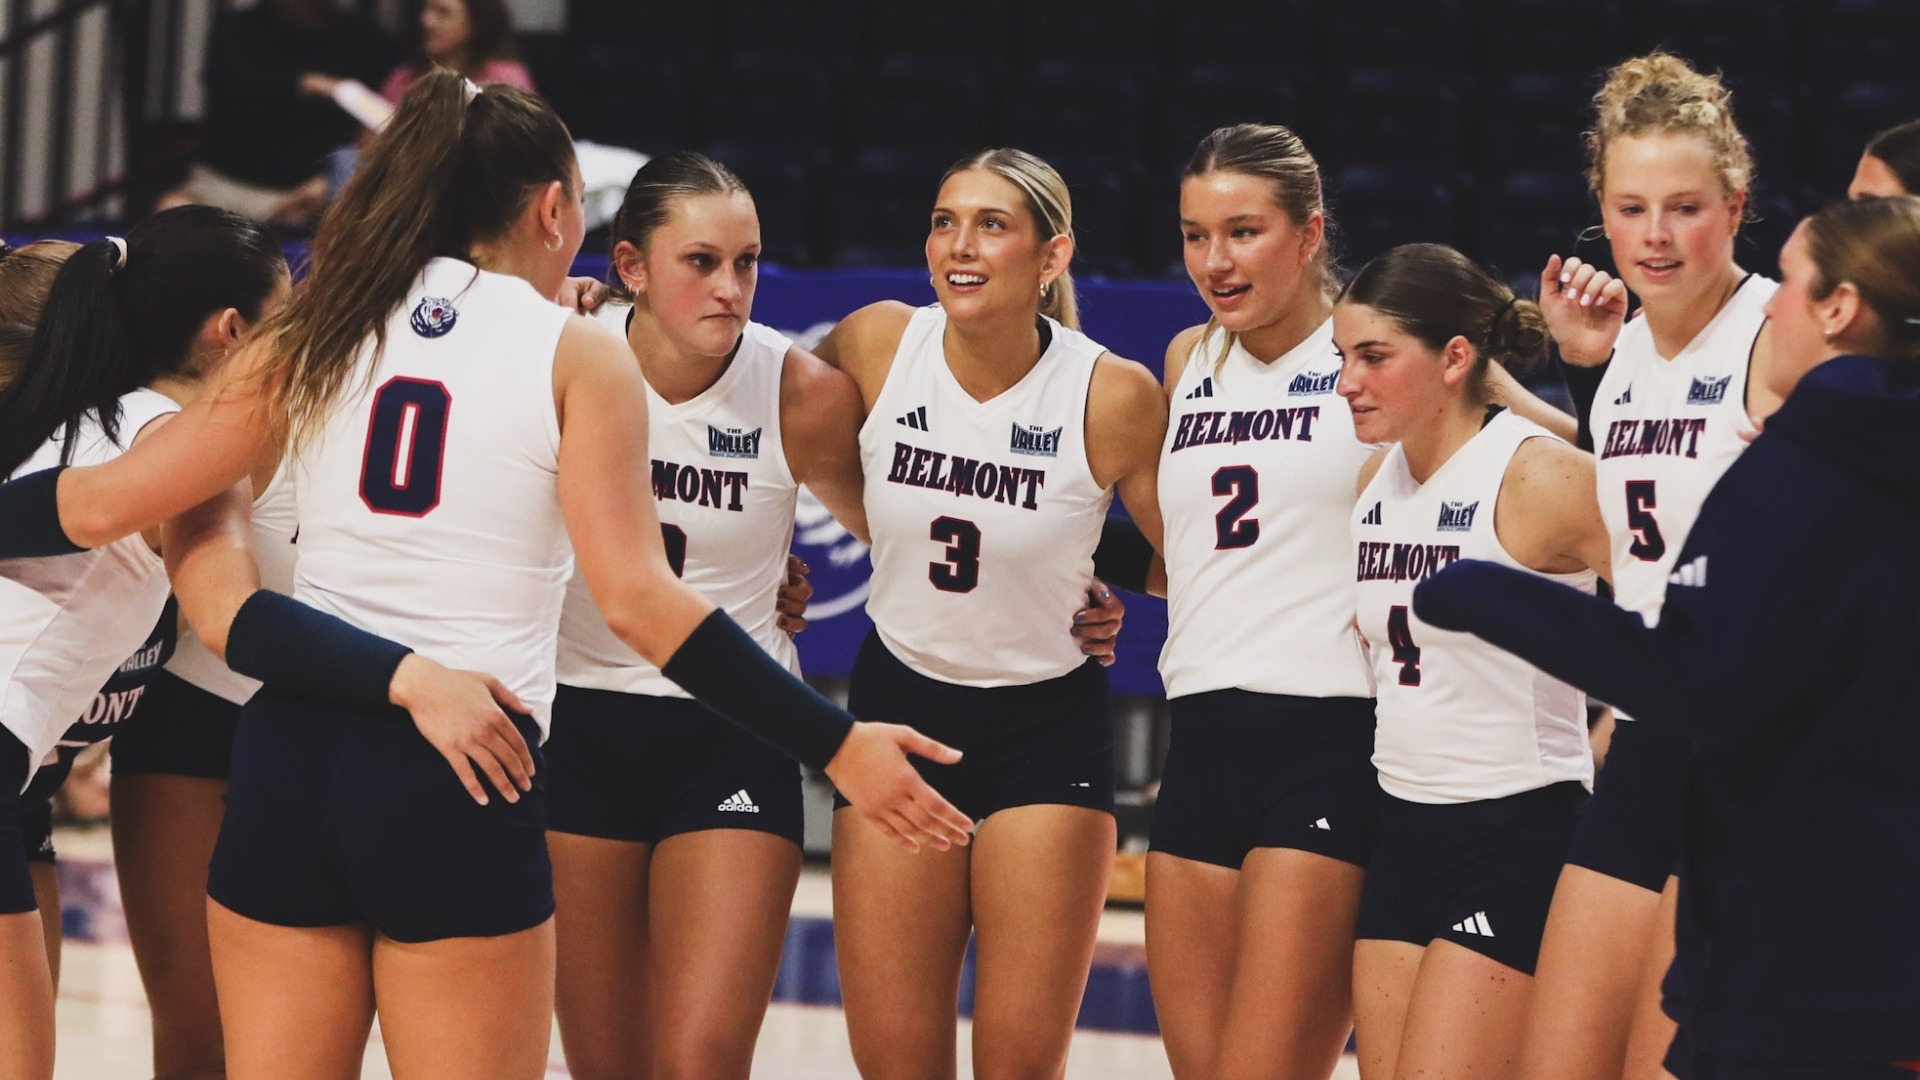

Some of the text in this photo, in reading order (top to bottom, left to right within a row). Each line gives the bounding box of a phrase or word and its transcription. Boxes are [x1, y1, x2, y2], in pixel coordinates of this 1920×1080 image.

[358, 375, 452, 518] 0
[708, 425, 762, 454] VALLEY
[1011, 422, 1063, 452] VALLEY
[1170, 406, 1320, 454] BELMONT
[1600, 418, 1706, 460] BELMONT
[887, 441, 1045, 511] BELMONT
[1211, 464, 1260, 550] 2
[928, 515, 981, 593] 3
[1625, 480, 1665, 562] 5
[1387, 605, 1421, 687] 4
[717, 803, 760, 814] adidas
